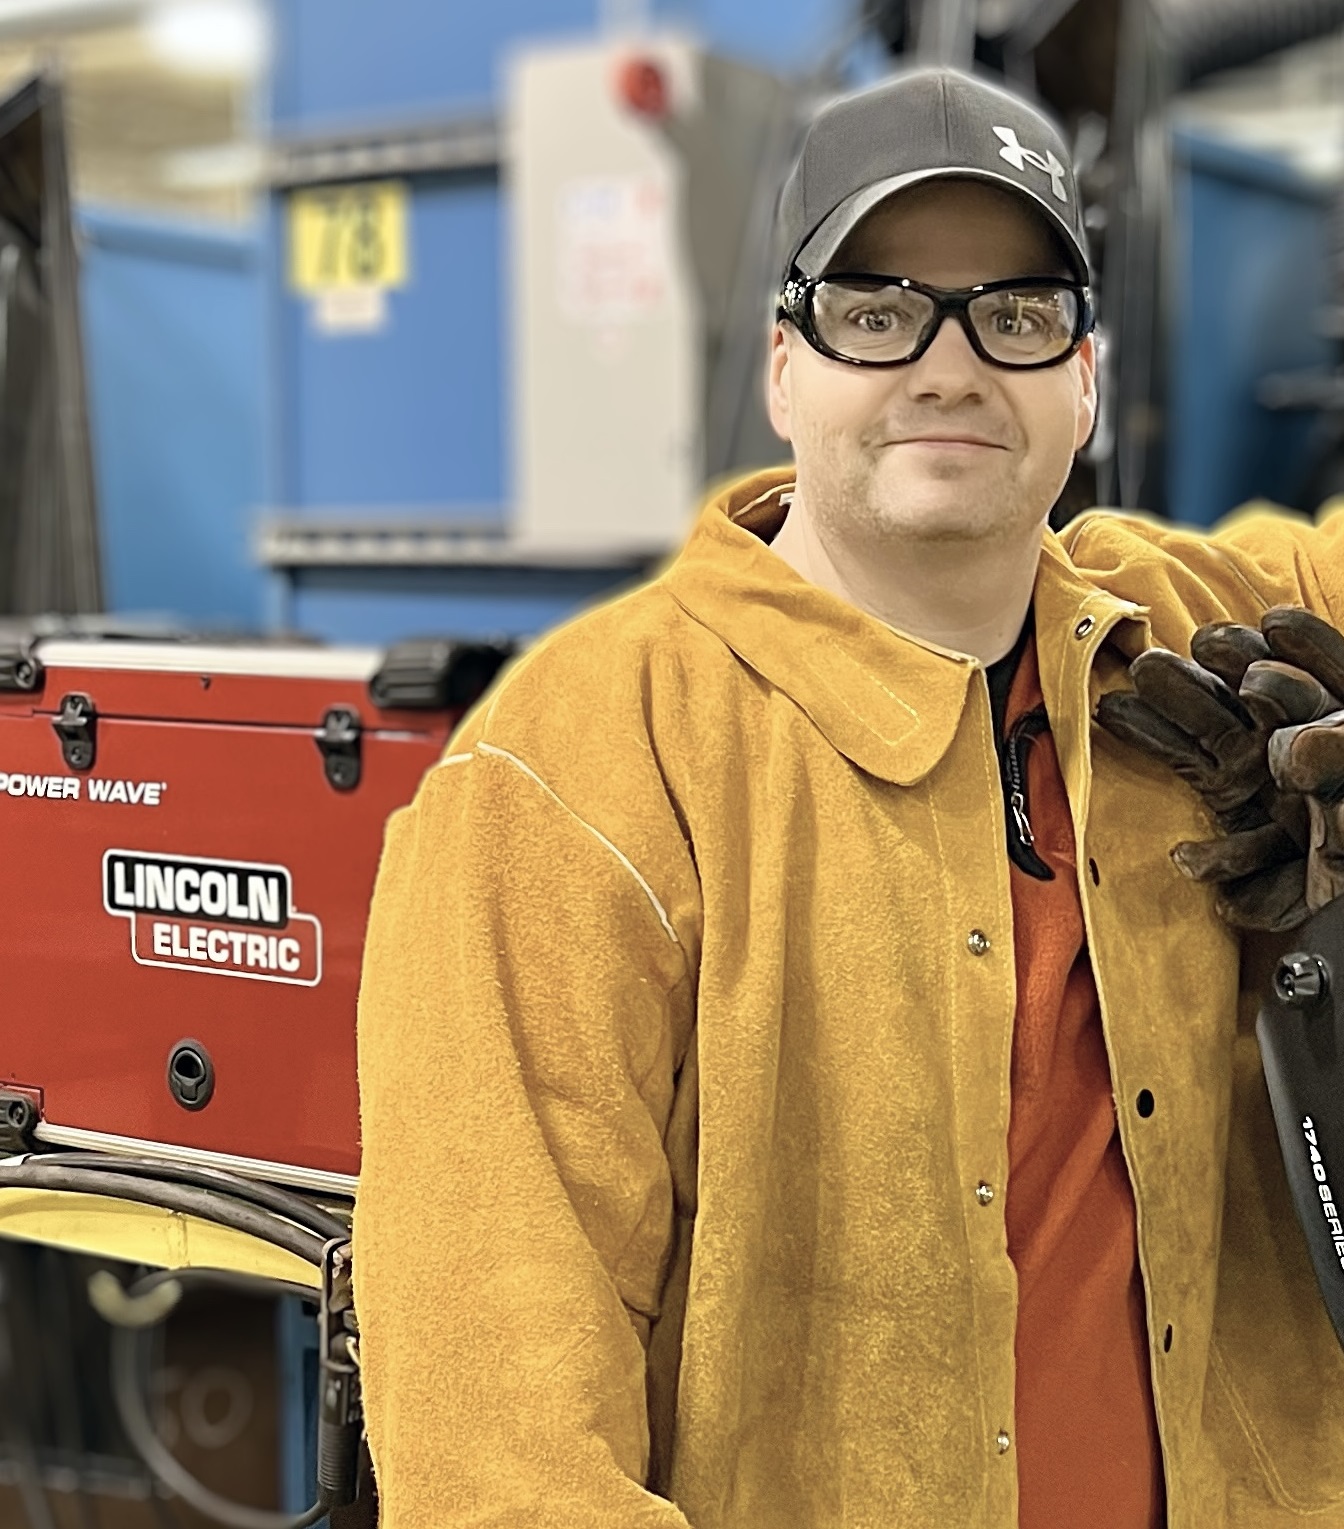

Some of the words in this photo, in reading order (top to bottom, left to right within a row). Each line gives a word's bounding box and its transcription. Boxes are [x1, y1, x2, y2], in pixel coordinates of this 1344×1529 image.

[309, 188, 386, 282] 78
[88, 778, 162, 806] WAVE
[113, 861, 280, 923] LINCOLN
[153, 922, 300, 972] ELECTRIC
[1302, 1115, 1327, 1182] 1740
